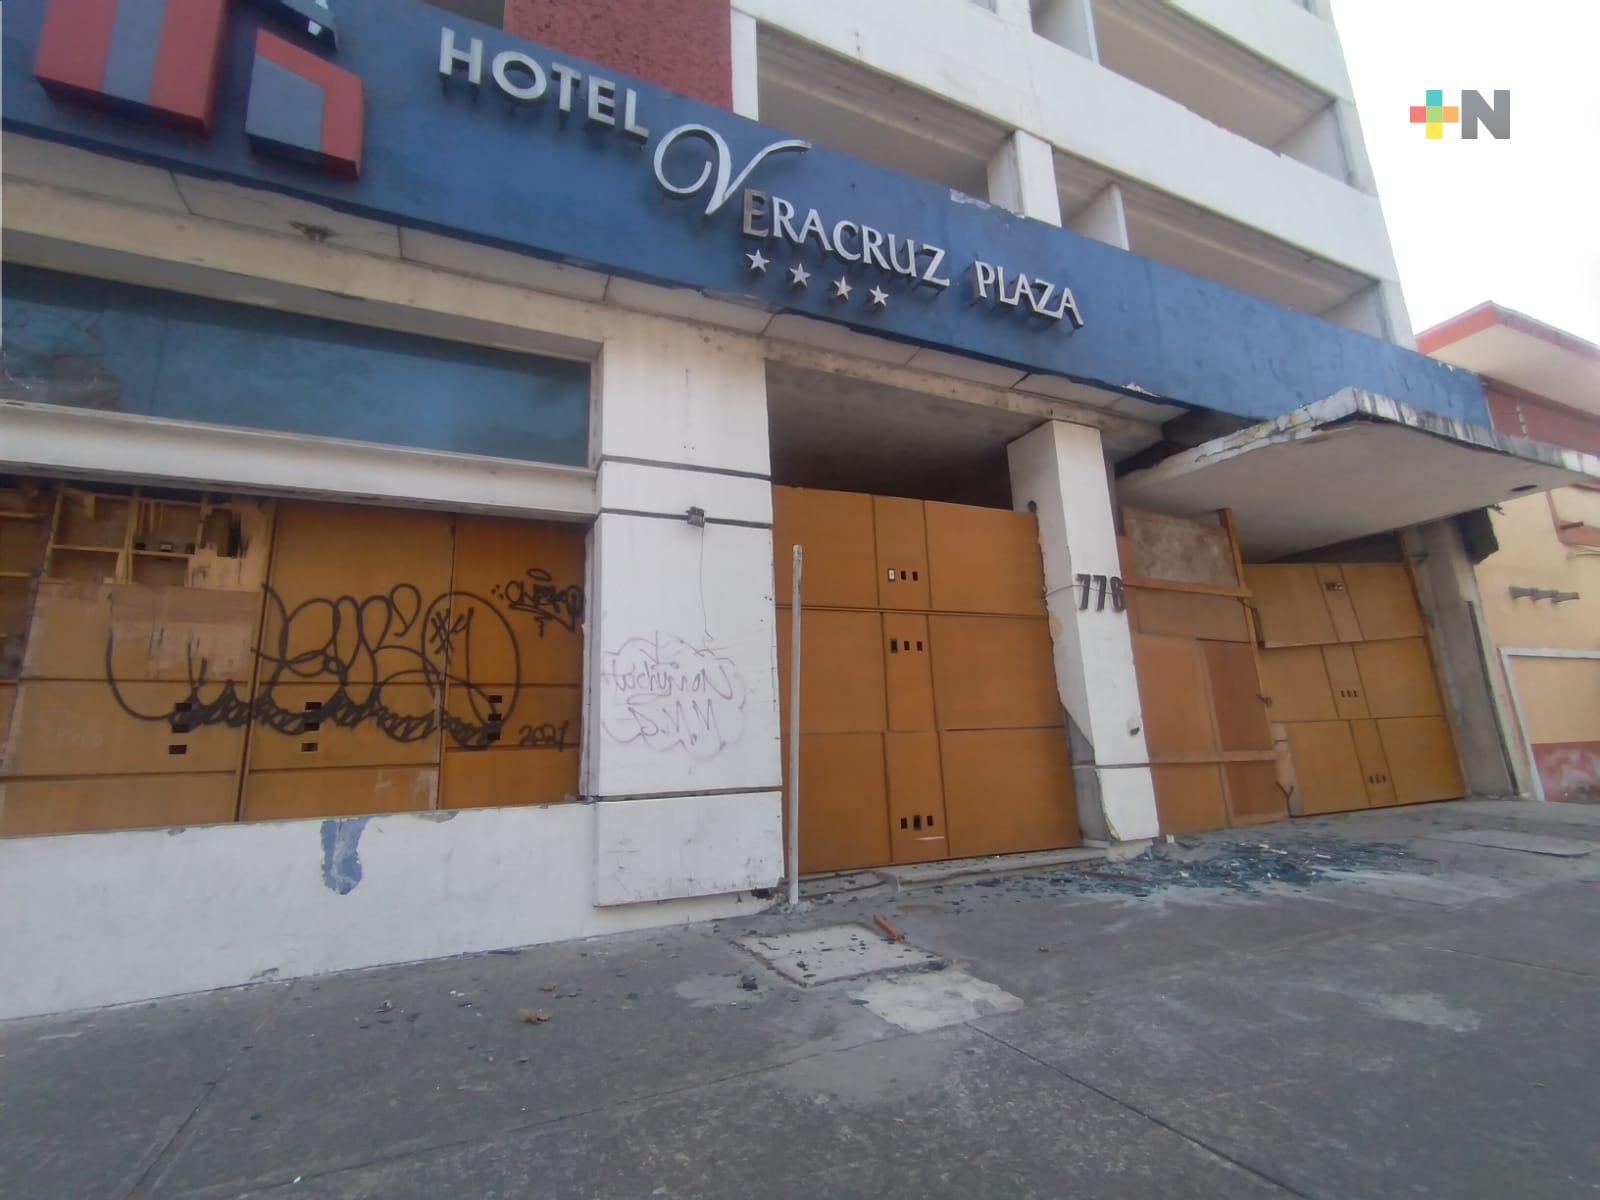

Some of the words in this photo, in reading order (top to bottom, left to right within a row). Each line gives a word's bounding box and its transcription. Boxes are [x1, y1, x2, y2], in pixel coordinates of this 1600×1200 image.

[438, 26, 650, 140] HOTEL
[653, 123, 951, 288] VERACRUZ
[972, 260, 1085, 330] PLAZA
